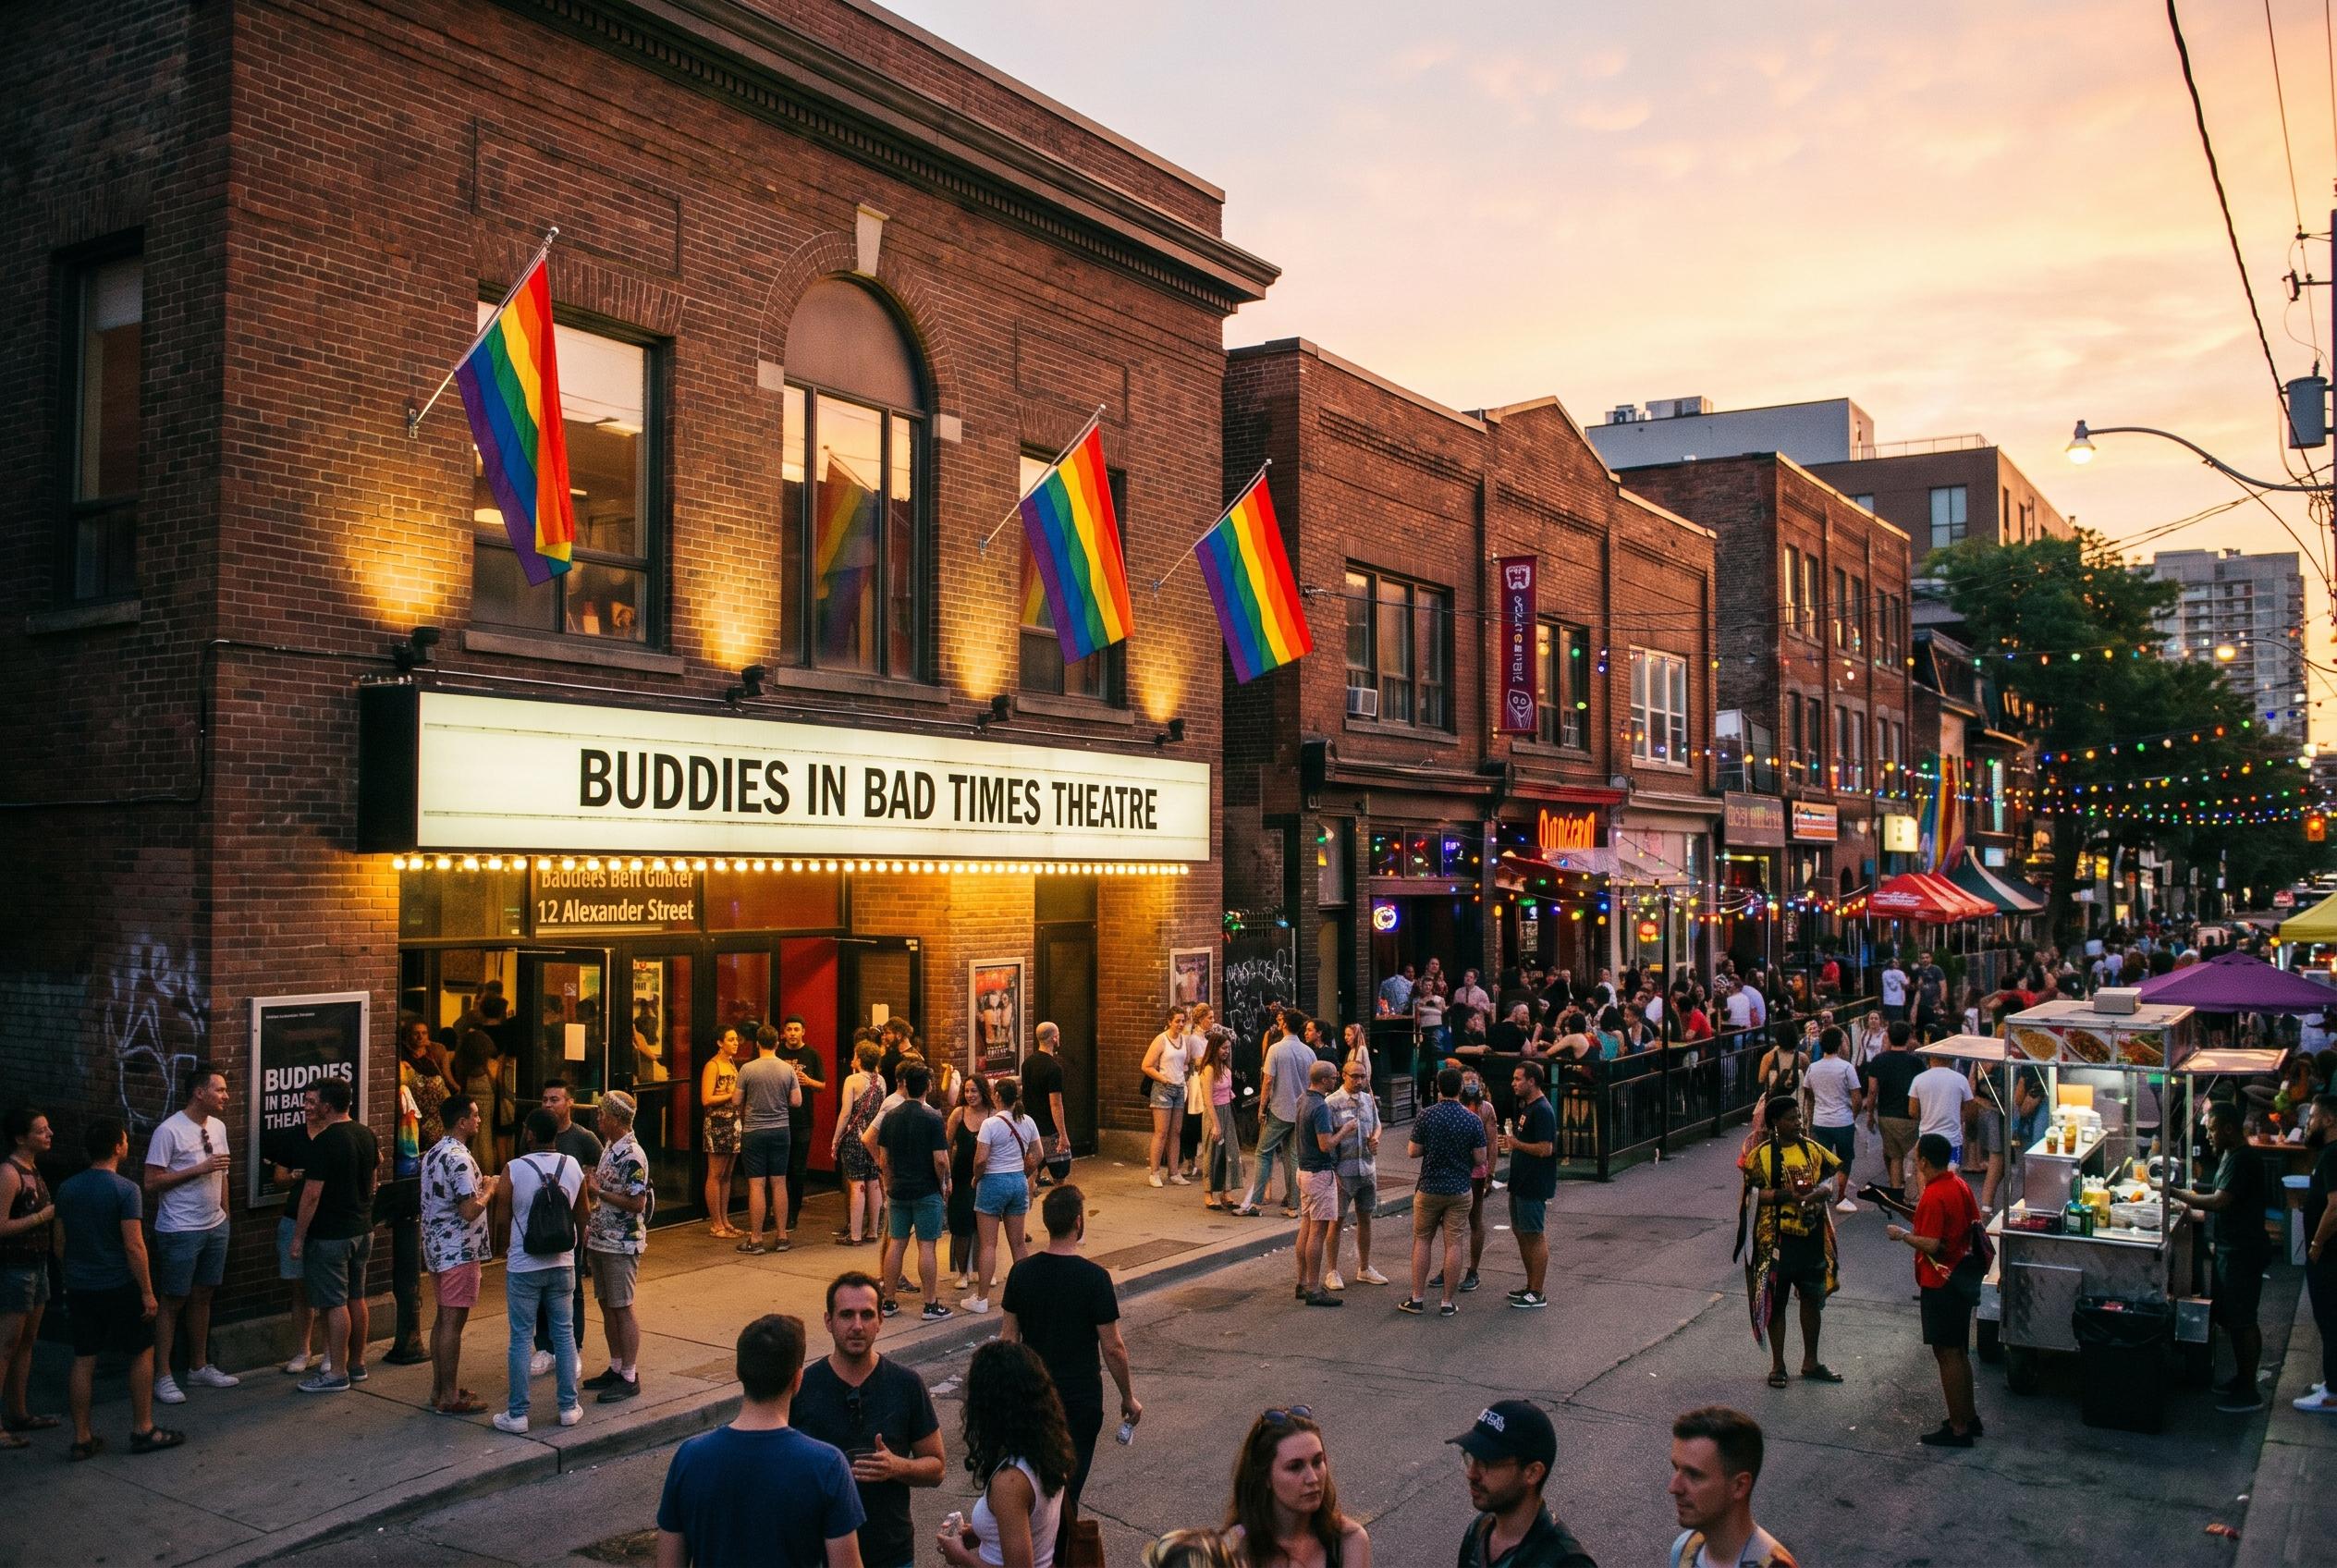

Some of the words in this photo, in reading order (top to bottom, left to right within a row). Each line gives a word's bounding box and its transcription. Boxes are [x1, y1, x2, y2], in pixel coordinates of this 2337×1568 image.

[580, 748, 789, 815] BUDDIES
[808, 763, 846, 816] IN
[864, 767, 936, 820] BAD
[948, 773, 1041, 826] TIMES
[1051, 781, 1157, 830] THEATRE
[538, 900, 558, 923] 12
[562, 899, 644, 923] Alexander
[648, 899, 694, 921] Street
[265, 1062, 352, 1092] BUDDIES
[265, 1095, 277, 1110] IN
[264, 1110, 306, 1130] THEAT
